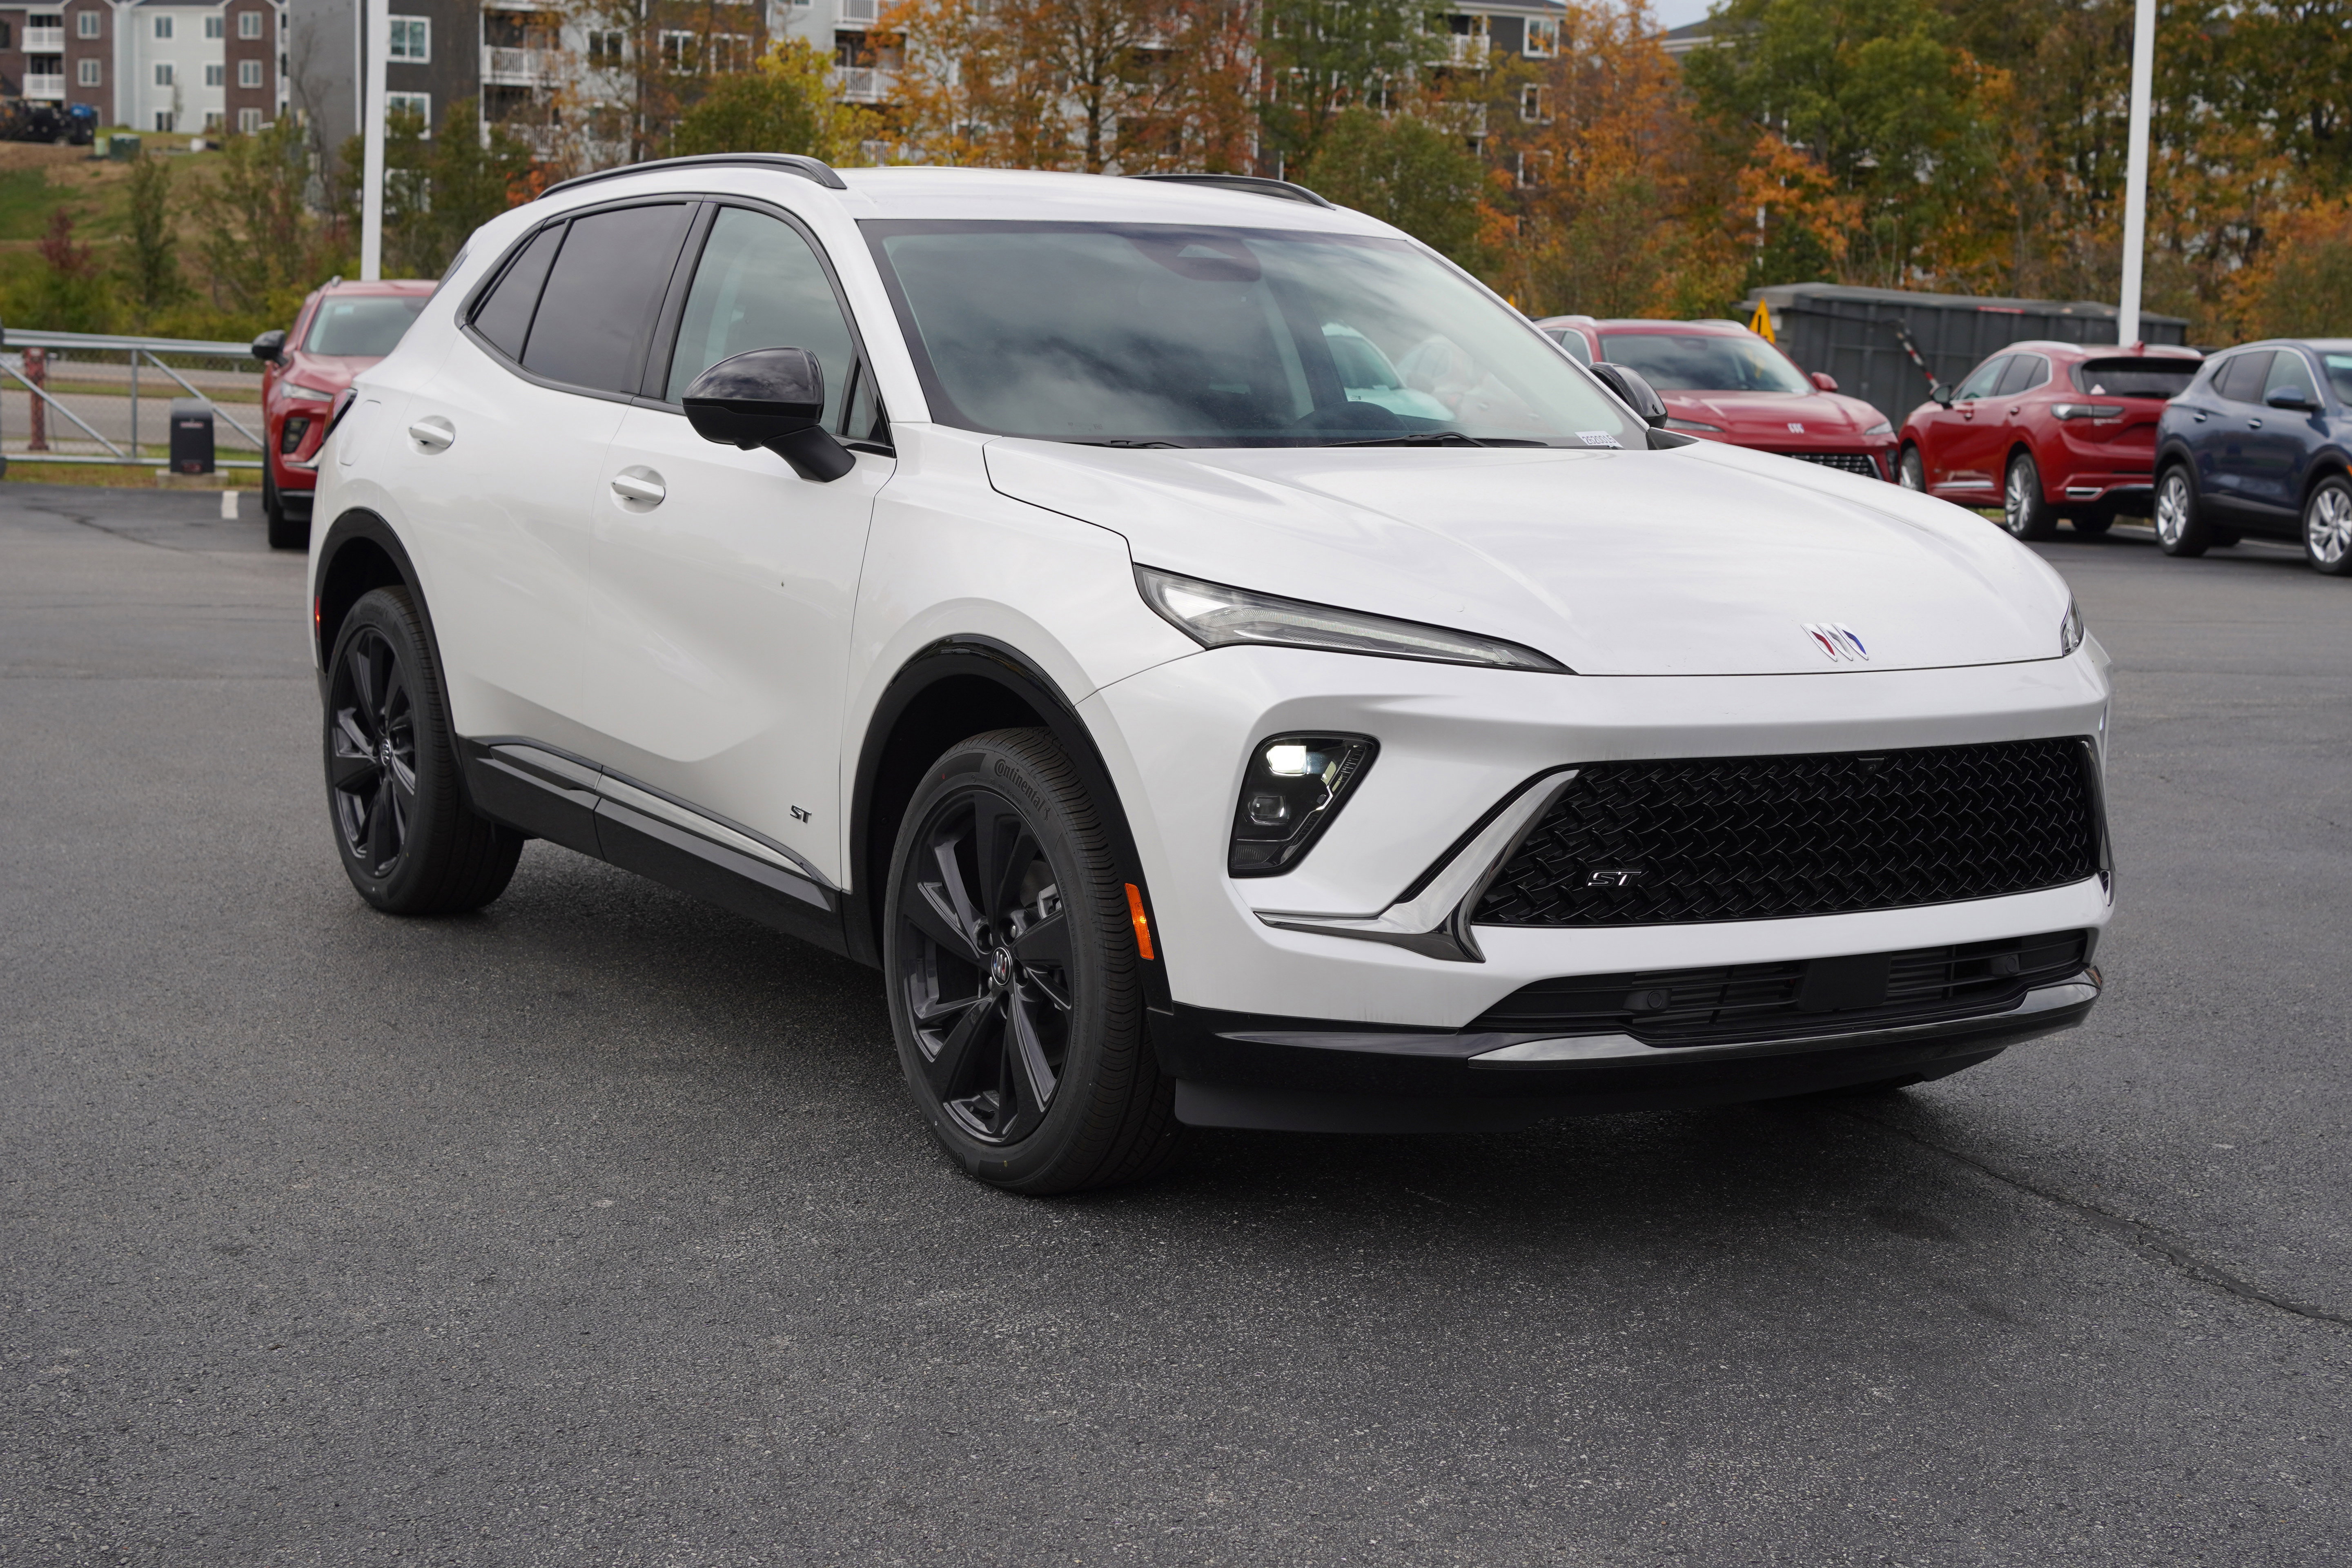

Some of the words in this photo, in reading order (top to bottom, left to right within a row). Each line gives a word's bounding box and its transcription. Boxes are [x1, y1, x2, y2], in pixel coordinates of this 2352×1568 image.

[994, 758, 1045, 813] Continental
[790, 804, 812, 824] ST
[1586, 869, 1642, 886] ST
